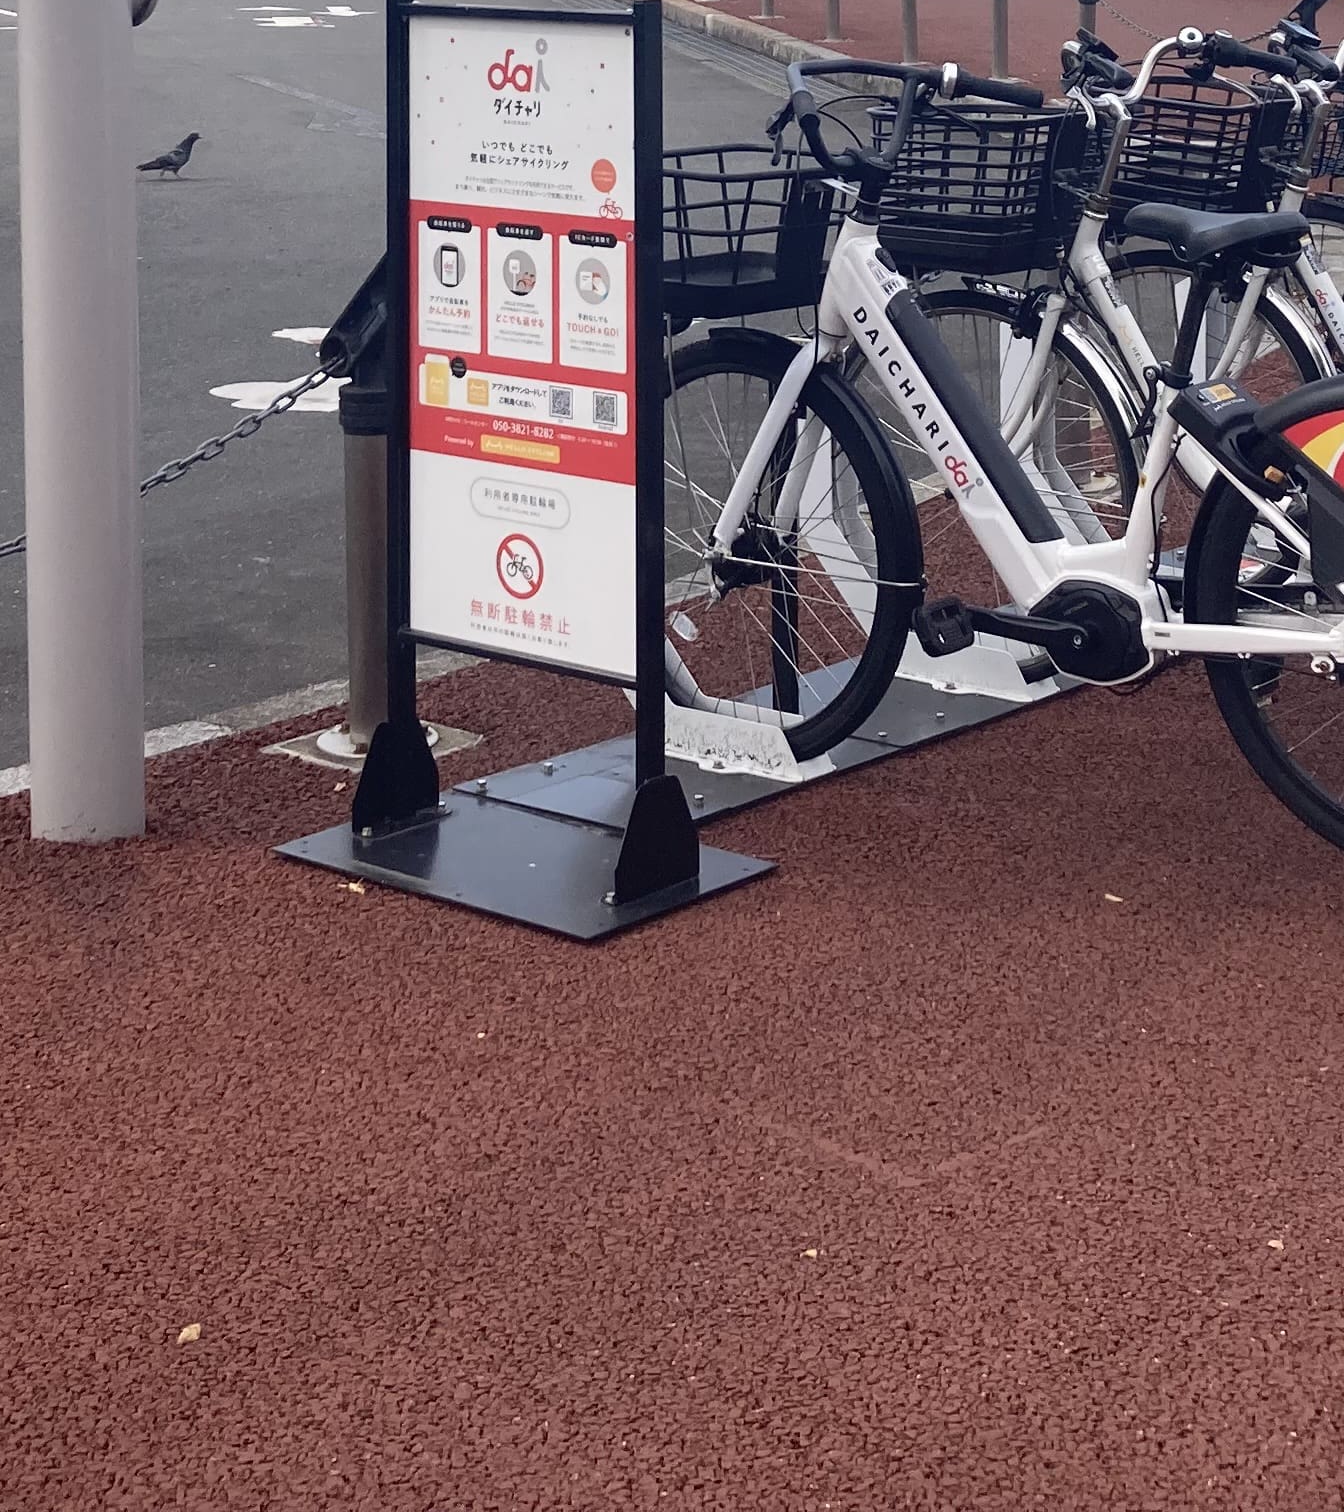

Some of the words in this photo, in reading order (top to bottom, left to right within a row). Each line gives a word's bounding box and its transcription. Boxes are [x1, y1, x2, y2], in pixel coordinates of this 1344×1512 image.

[493, 97, 541, 118] ダイチャリ
[481, 140, 516, 152] いつでも
[520, 143, 553, 156] どこでも
[470, 152, 569, 170] 気軽にシェアサイクリング
[566, 322, 597, 334] TOUCH
[852, 306, 950, 452] DAICHARI
[492, 419, 554, 439] 050-3821-8282
[471, 598, 571, 635] 無断駐輪禁止
